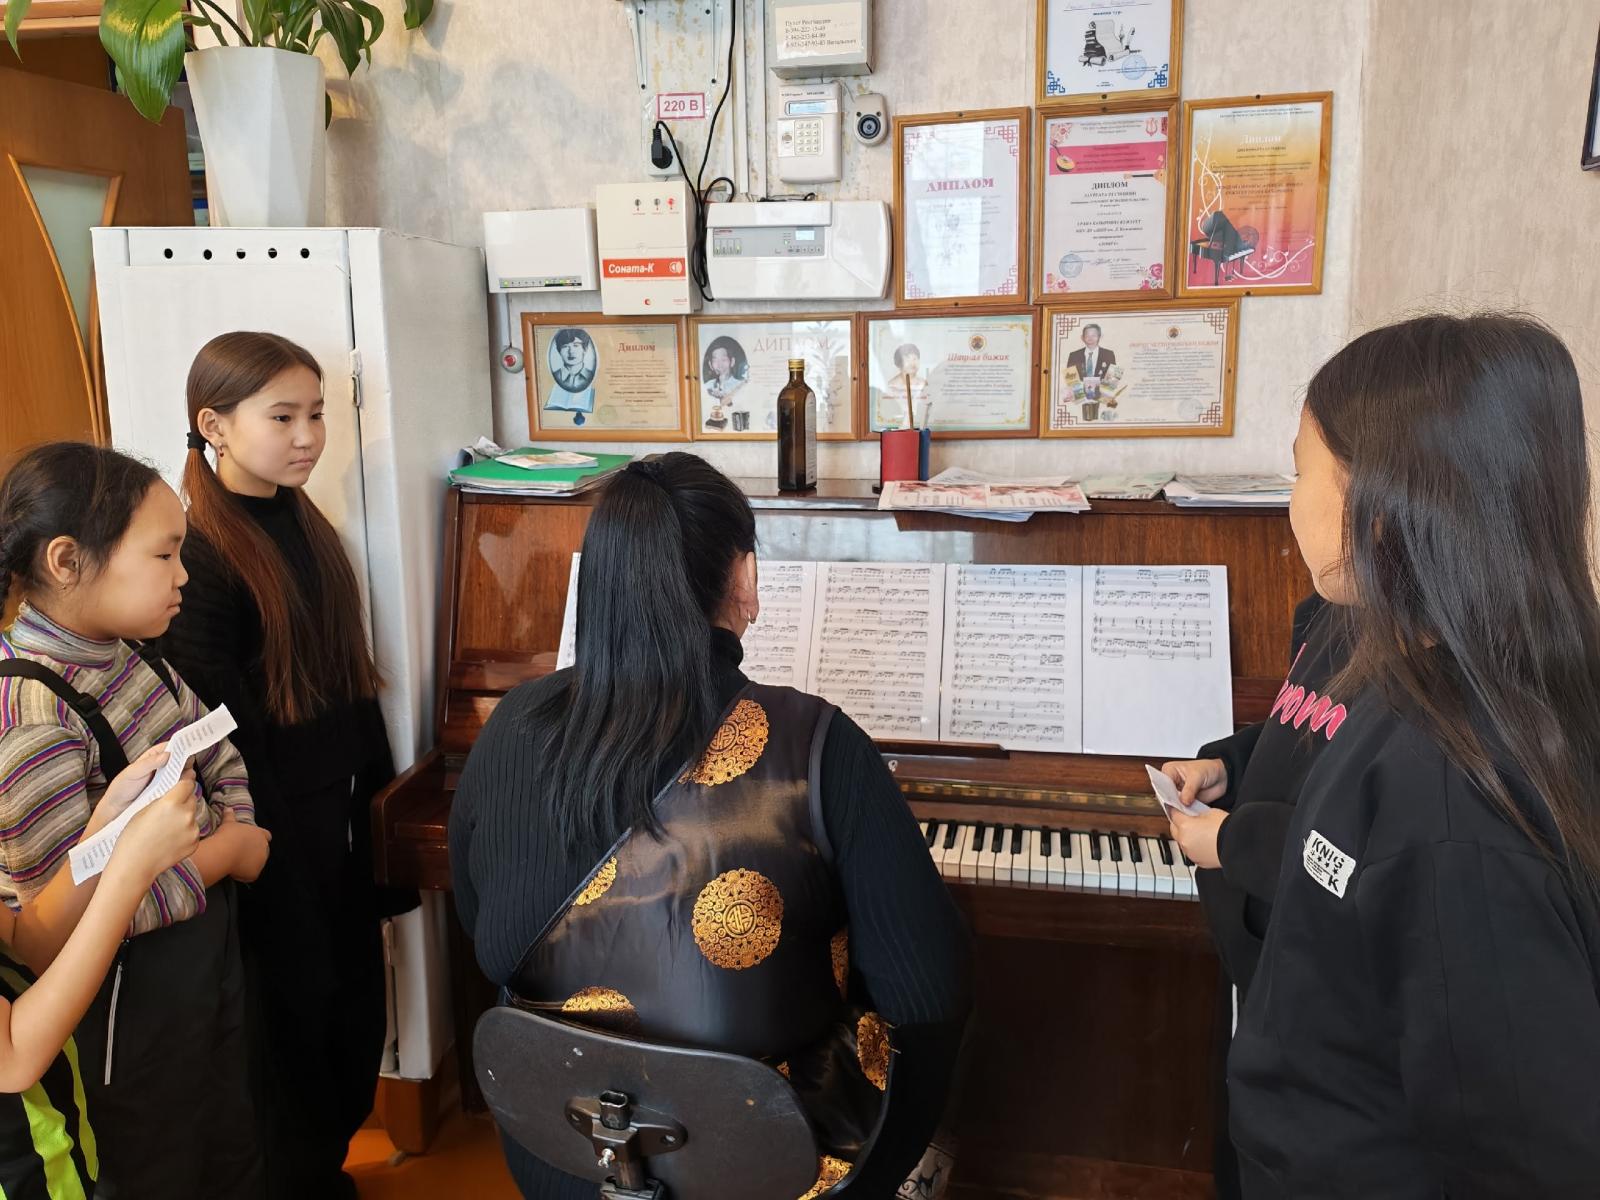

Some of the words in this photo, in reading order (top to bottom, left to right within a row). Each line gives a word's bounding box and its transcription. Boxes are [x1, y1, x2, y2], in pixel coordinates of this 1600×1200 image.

[664, 100, 685, 112] 220
[690, 100, 699, 111] В
[927, 178, 994, 192] ДИПЛОМ
[1091, 181, 1128, 190] ДИПЛОМ
[608, 263, 655, 274] Соната-К
[618, 343, 656, 353] Диплом
